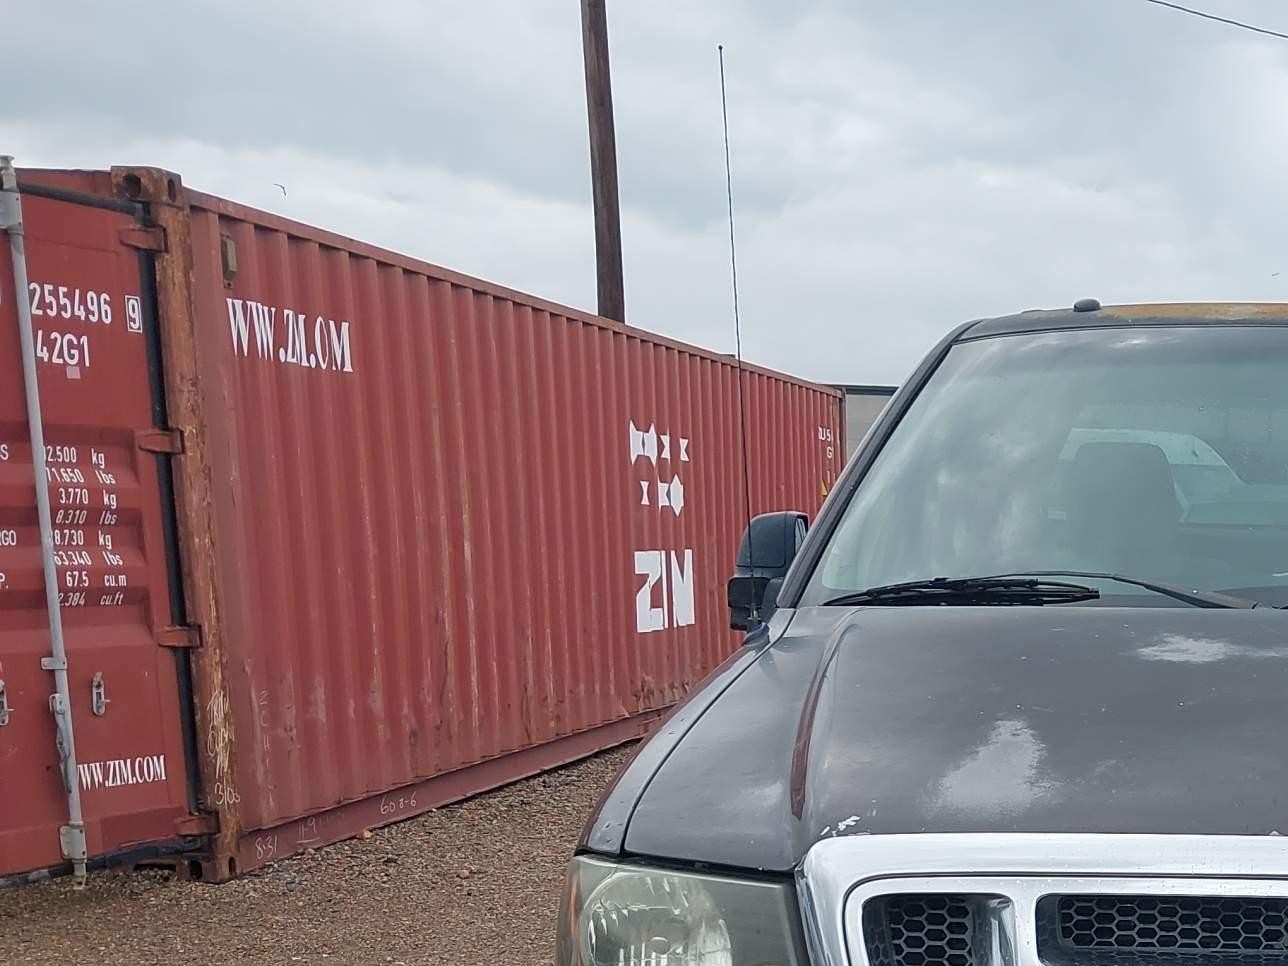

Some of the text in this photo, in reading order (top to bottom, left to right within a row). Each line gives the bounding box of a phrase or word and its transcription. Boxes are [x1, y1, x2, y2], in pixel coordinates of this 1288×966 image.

[29, 282, 140, 330] 255496 9
[37, 329, 90, 367] 42G1
[43, 446, 105, 469] 2.500 kg
[95, 470, 116, 484] lbs
[58, 488, 117, 509] 3.770 kg
[99, 511, 117, 524] lbs
[51, 530, 84, 546] 8.730
[98, 530, 112, 550] kg
[102, 551, 123, 566] lbs
[66, 571, 127, 587] 67.5 cu.m
[77, 755, 166, 791] WW.ZIM.COM
